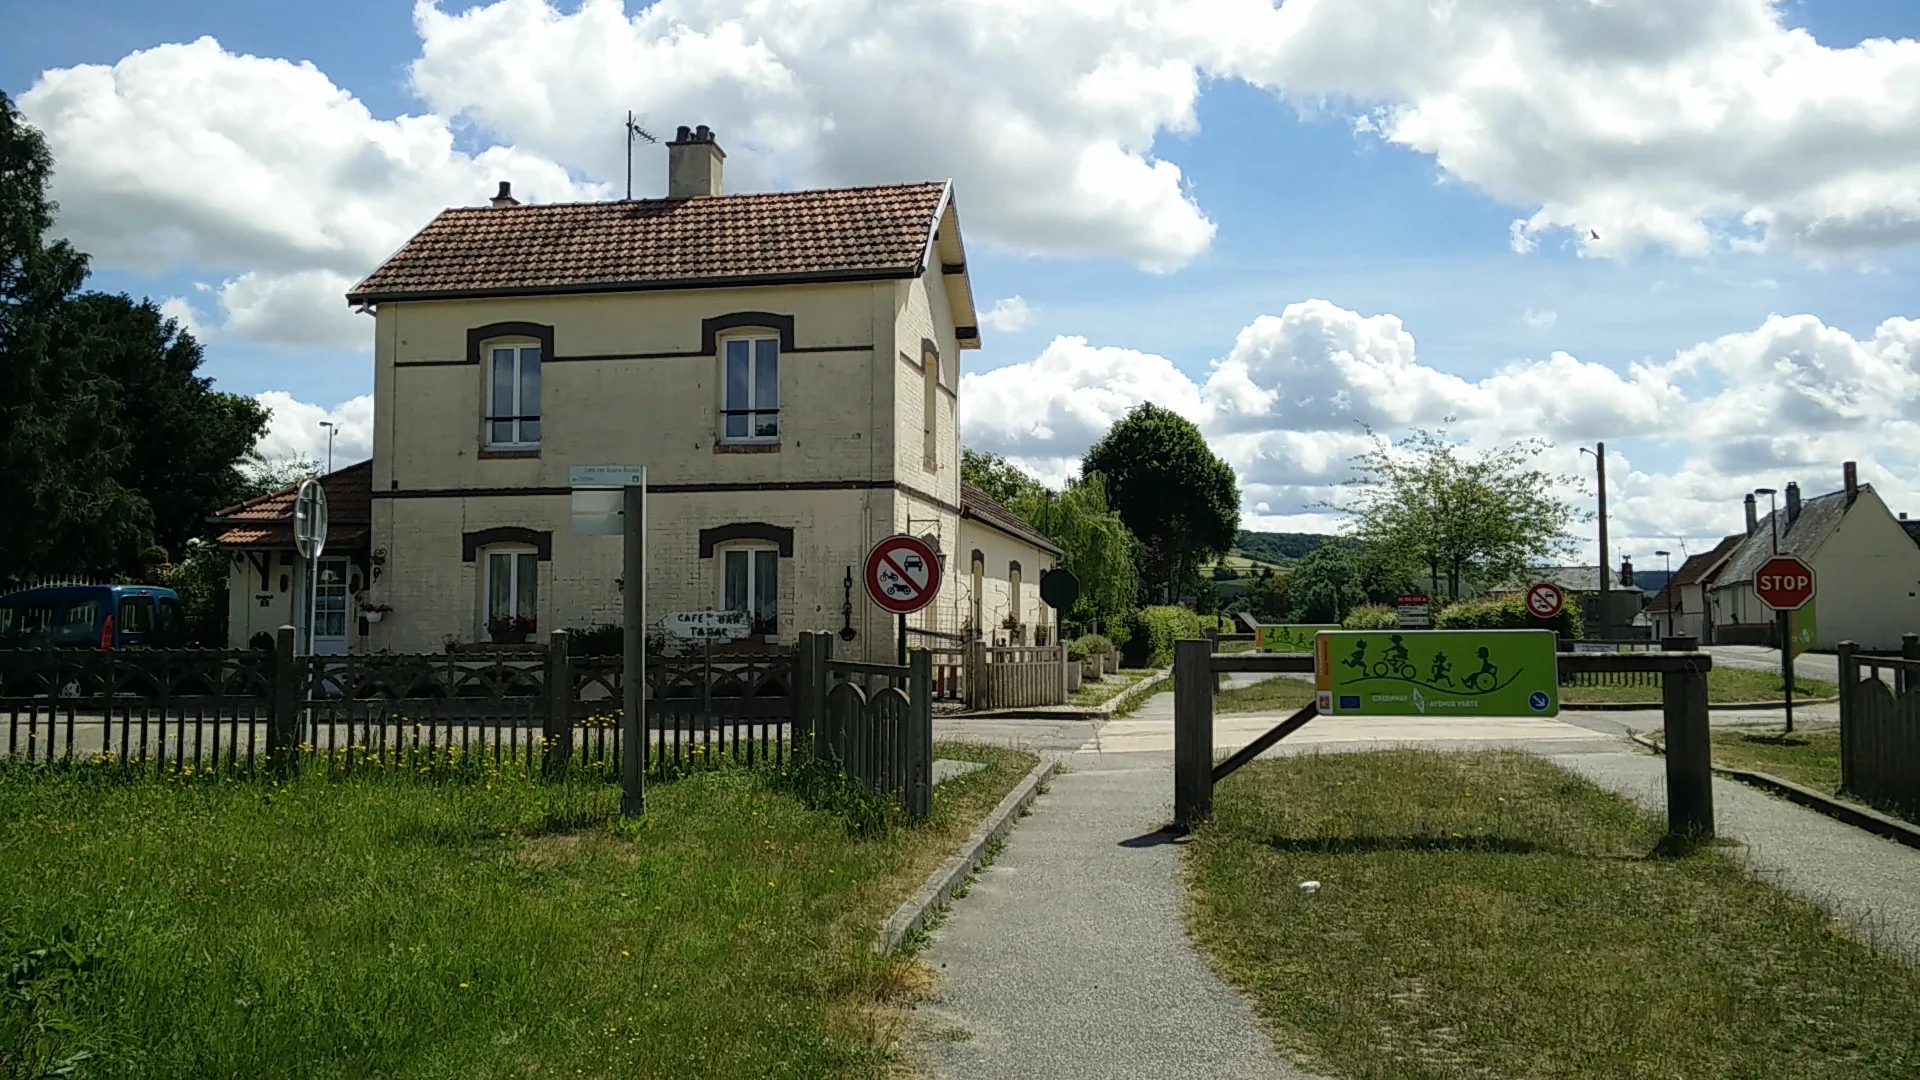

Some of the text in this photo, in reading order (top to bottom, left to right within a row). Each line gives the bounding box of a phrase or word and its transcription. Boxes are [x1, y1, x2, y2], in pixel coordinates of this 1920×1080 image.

[1760, 575, 1809, 591] STOP
[678, 614, 703, 623] CAFE
[690, 627, 728, 637] TABAC
[1429, 700, 1479, 708] AVENUE VERTE
